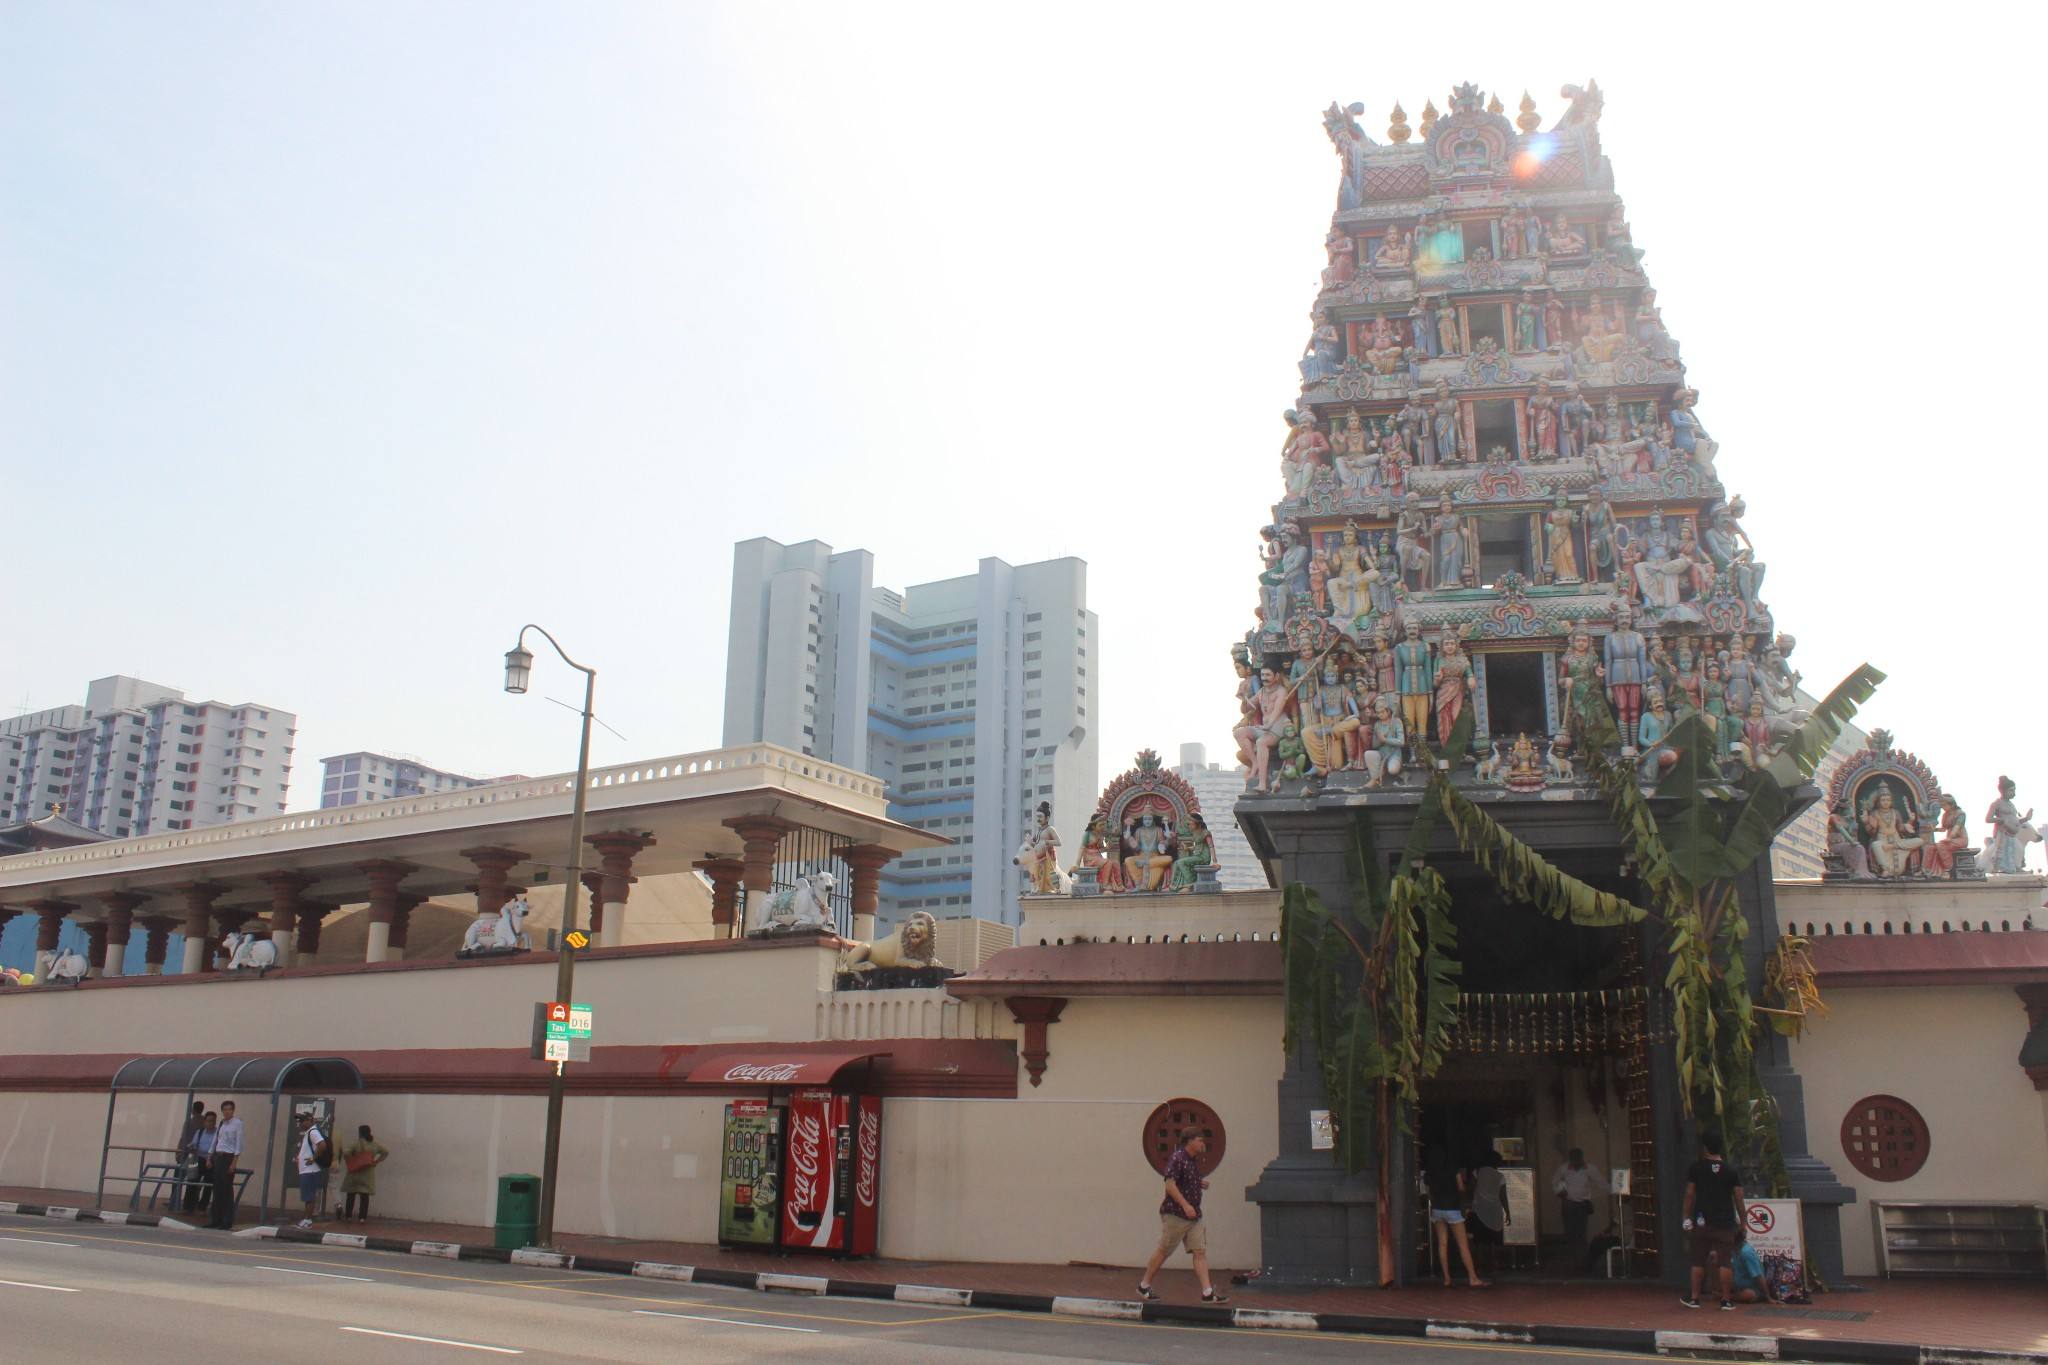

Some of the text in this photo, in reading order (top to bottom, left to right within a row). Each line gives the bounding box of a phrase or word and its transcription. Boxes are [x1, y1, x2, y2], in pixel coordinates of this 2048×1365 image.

[551, 1024, 566, 1032] Taxi
[571, 1019, 589, 1028] D16
[548, 1044, 555, 1056] 4
